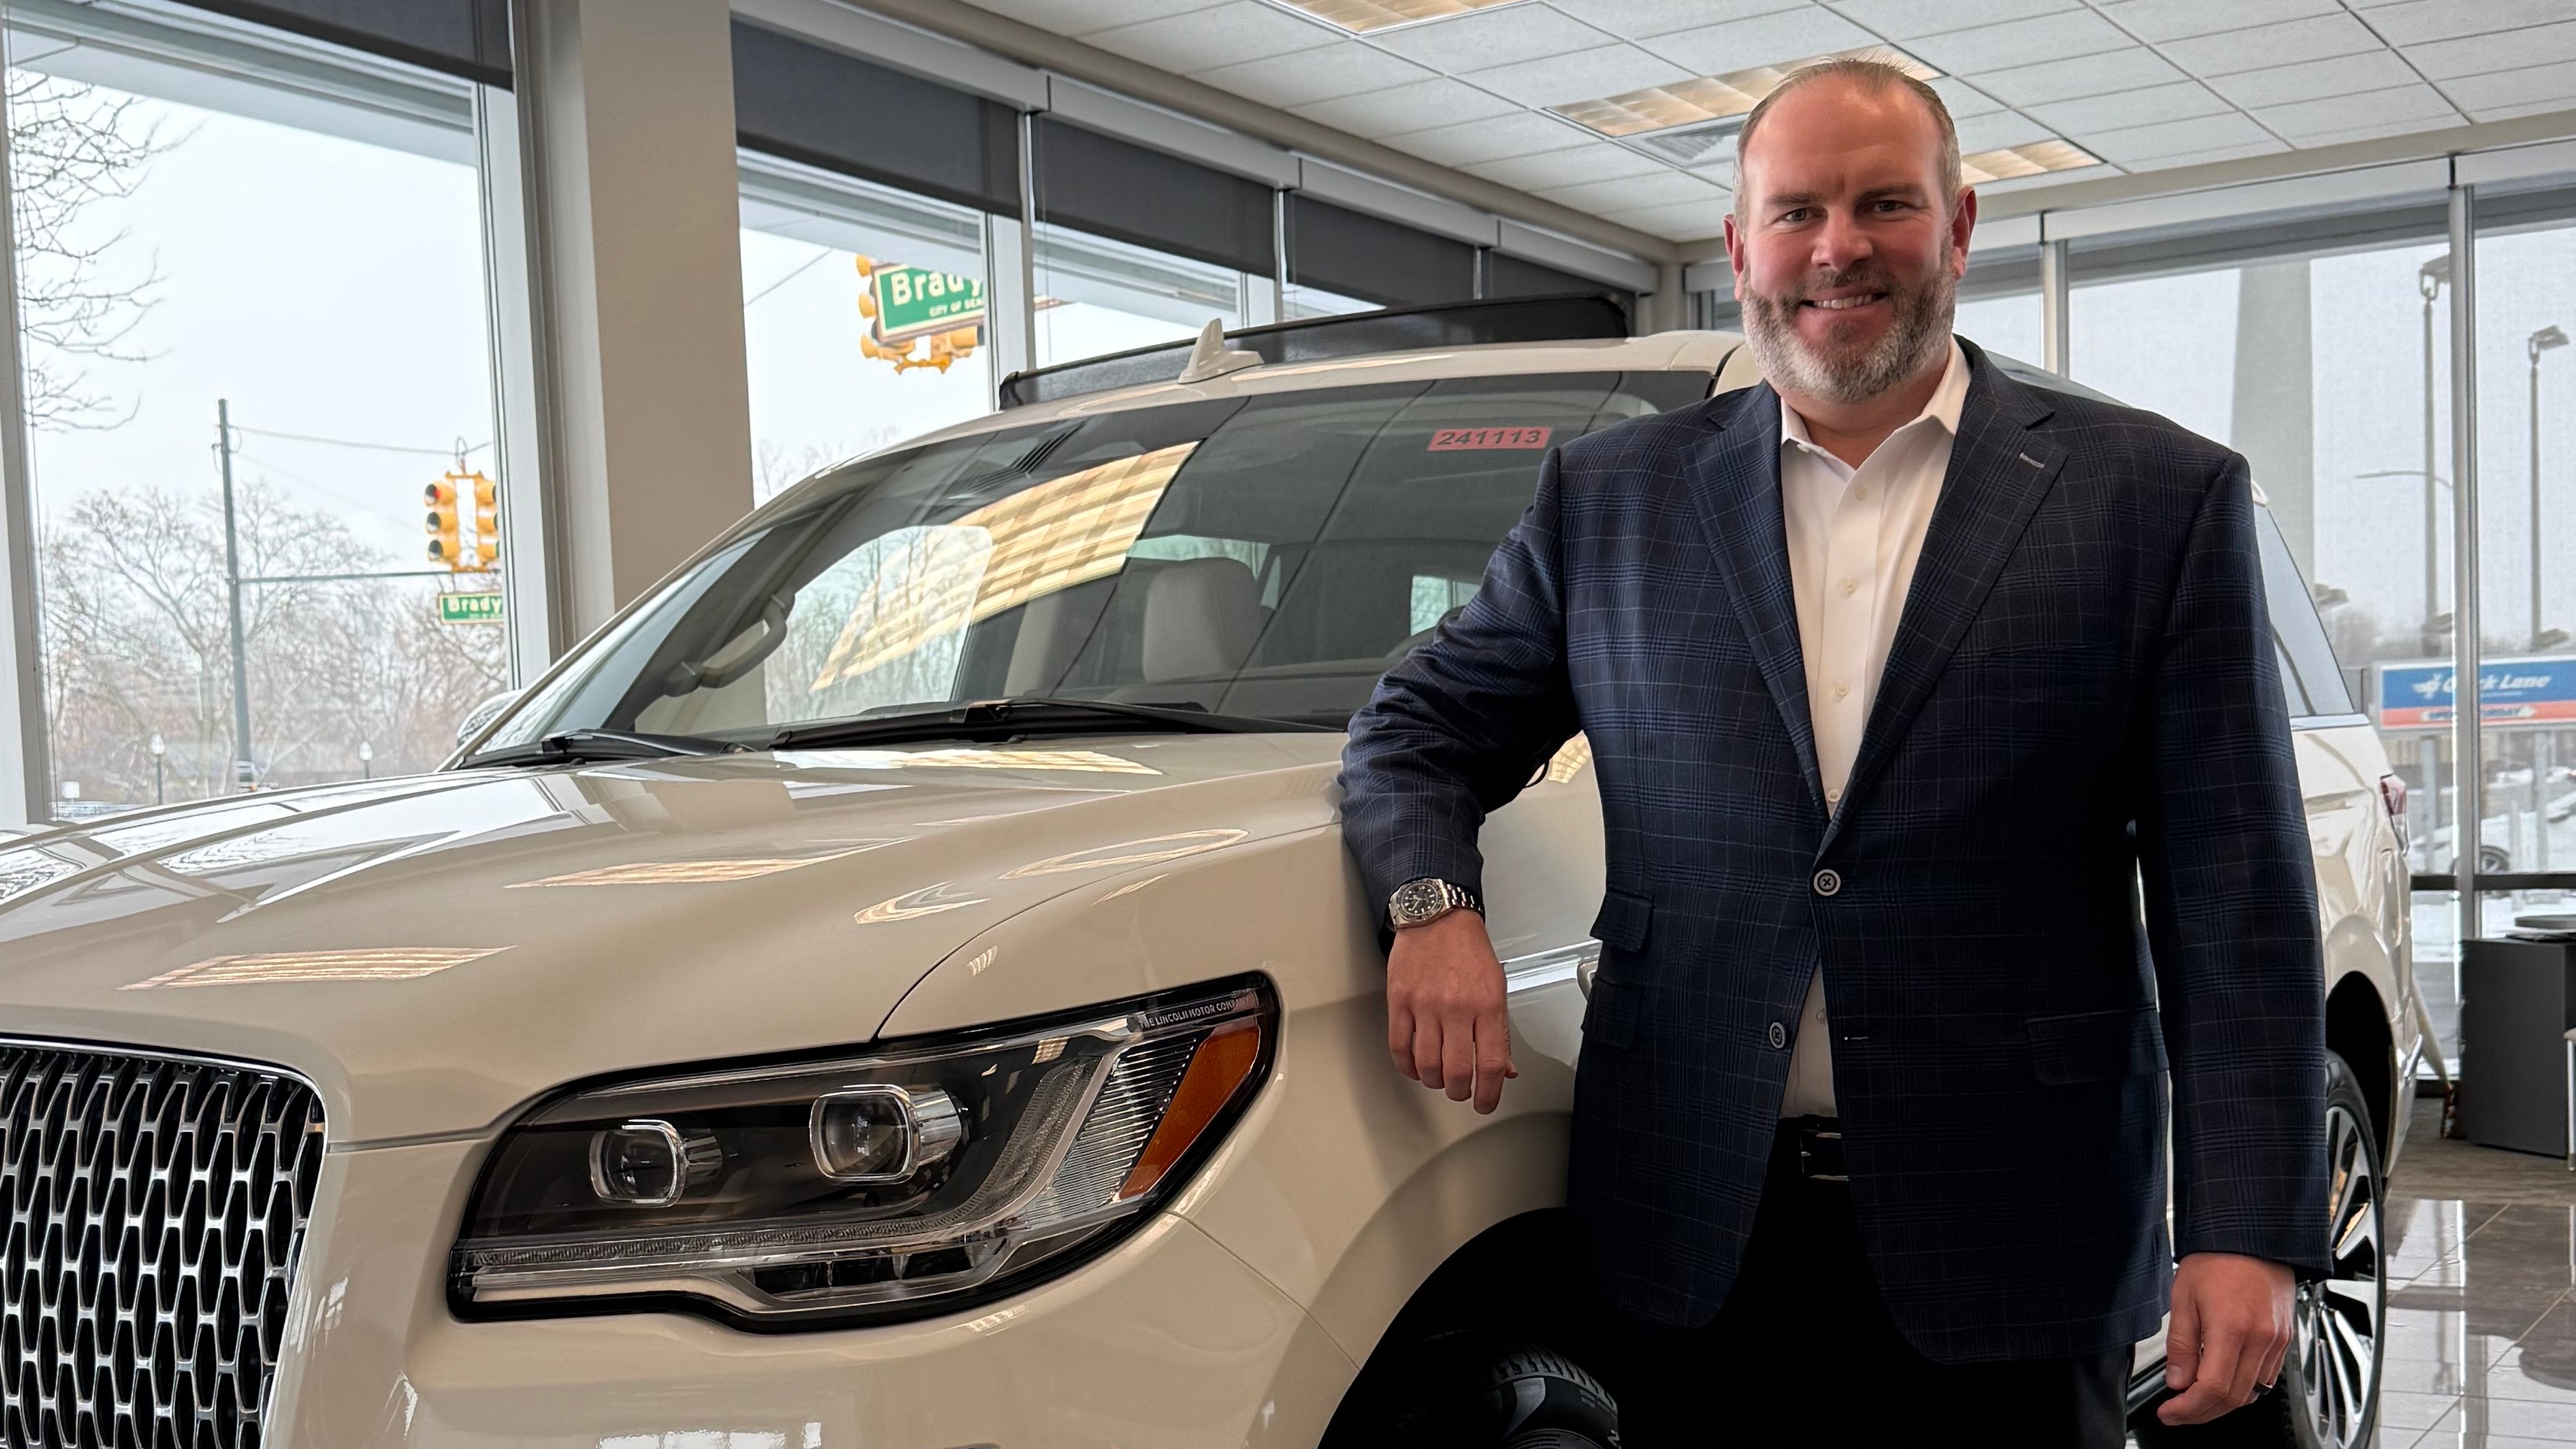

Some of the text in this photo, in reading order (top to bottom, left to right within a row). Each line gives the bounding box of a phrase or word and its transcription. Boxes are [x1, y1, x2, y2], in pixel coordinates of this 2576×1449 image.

[1436, 430, 1541, 446] 241113
[447, 596, 502, 614] Brady
[2498, 673, 2552, 690] Lane
[1155, 1011, 1188, 1026] LINCOLN
[1188, 1003, 1216, 1021] MOTOR
